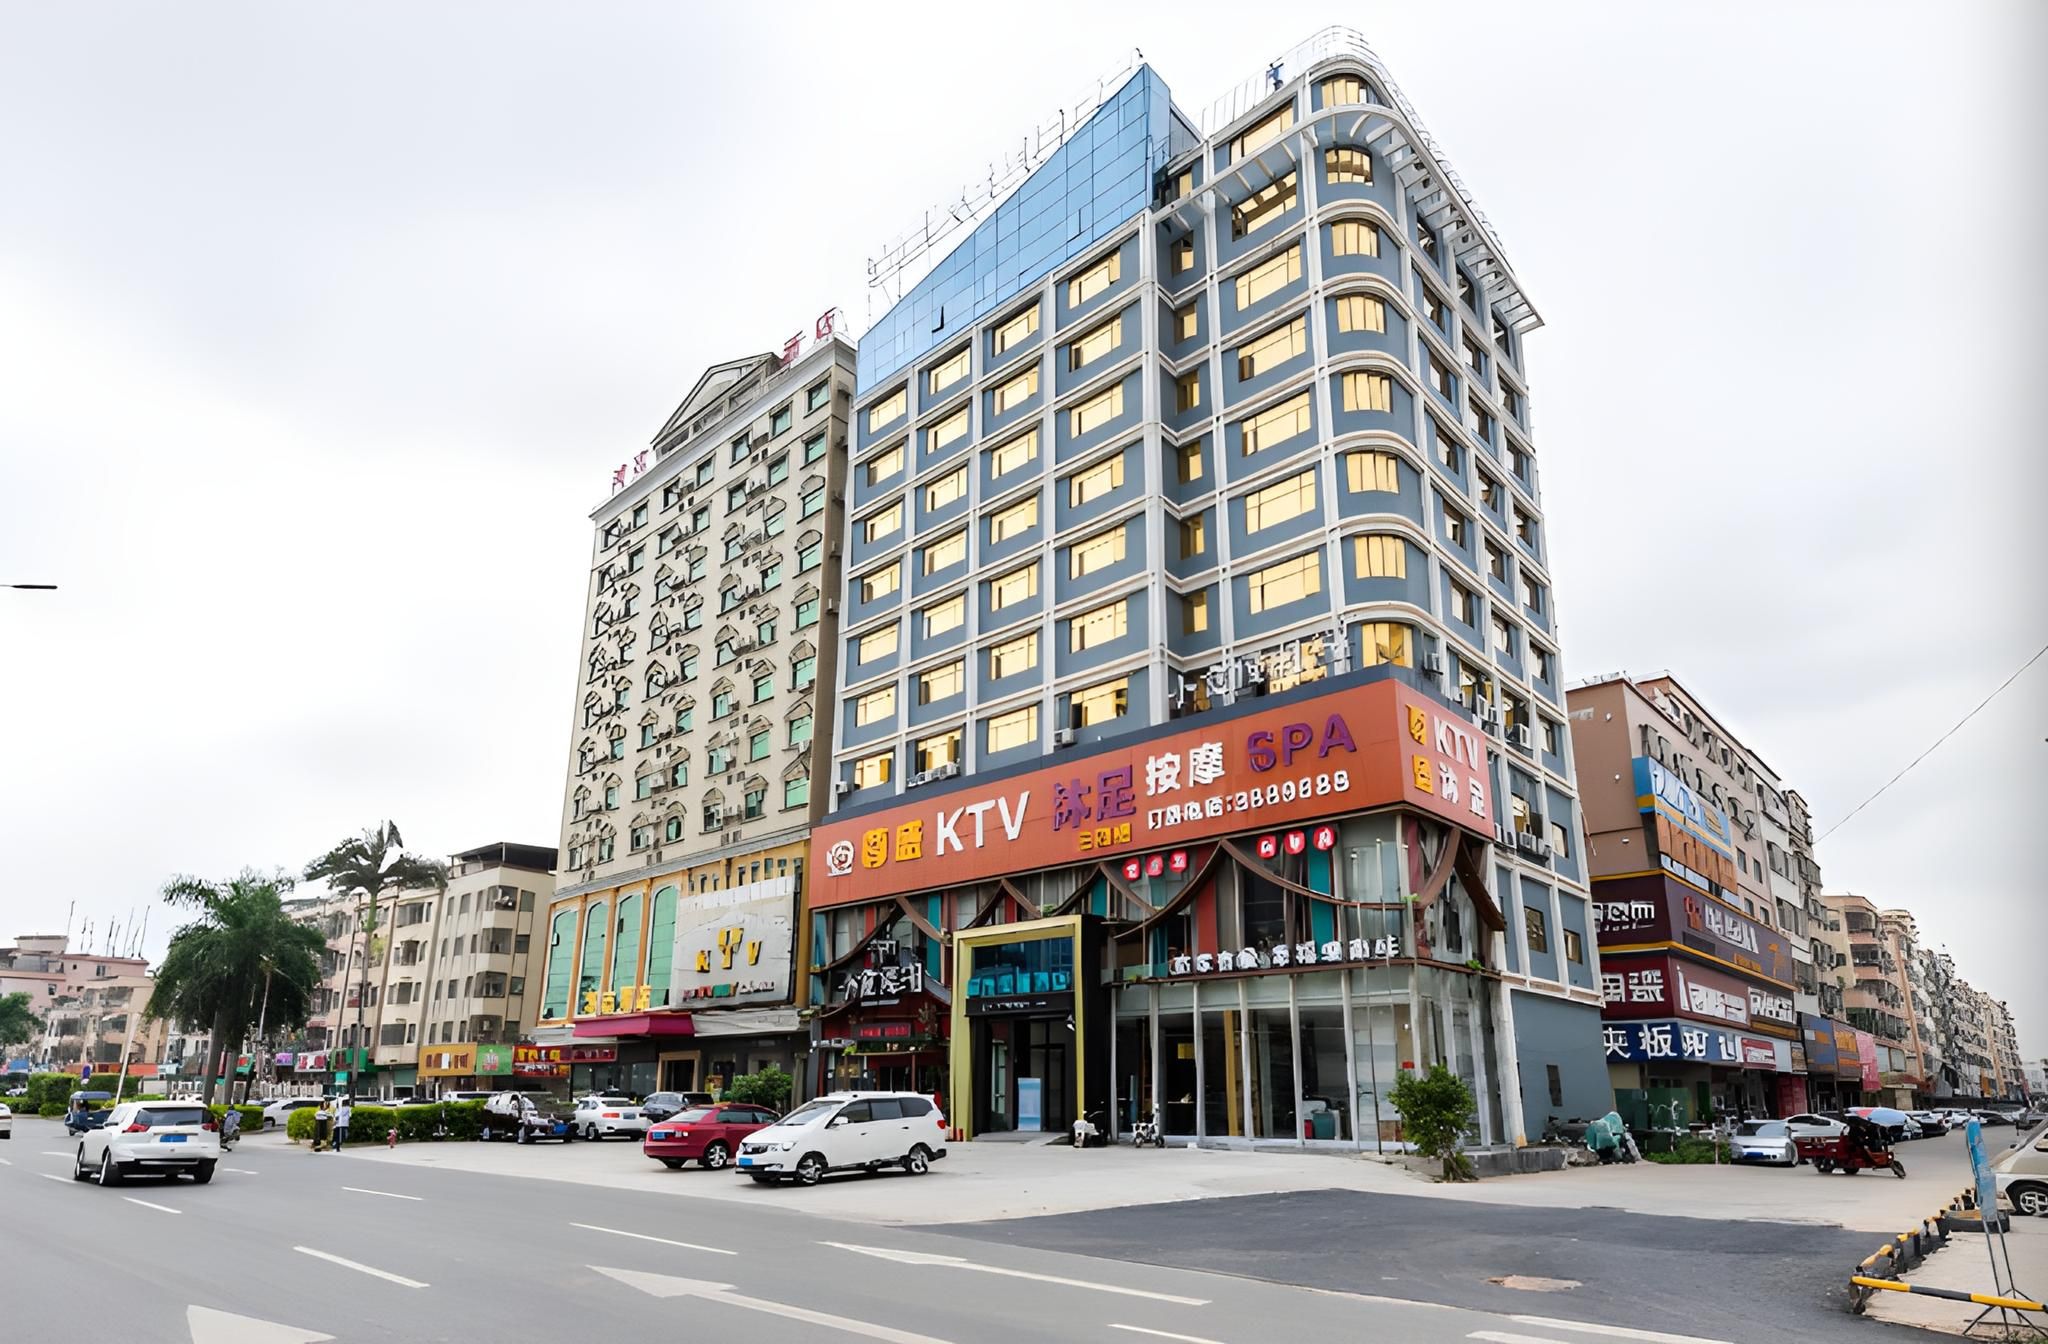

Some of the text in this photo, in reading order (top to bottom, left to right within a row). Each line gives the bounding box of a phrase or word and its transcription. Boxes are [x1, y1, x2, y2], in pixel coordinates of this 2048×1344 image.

[1145, 741, 1226, 796] 按摩
[1247, 713, 1357, 772] SPA
[1433, 715, 1479, 771] KTV
[935, 791, 1030, 856] KTV
